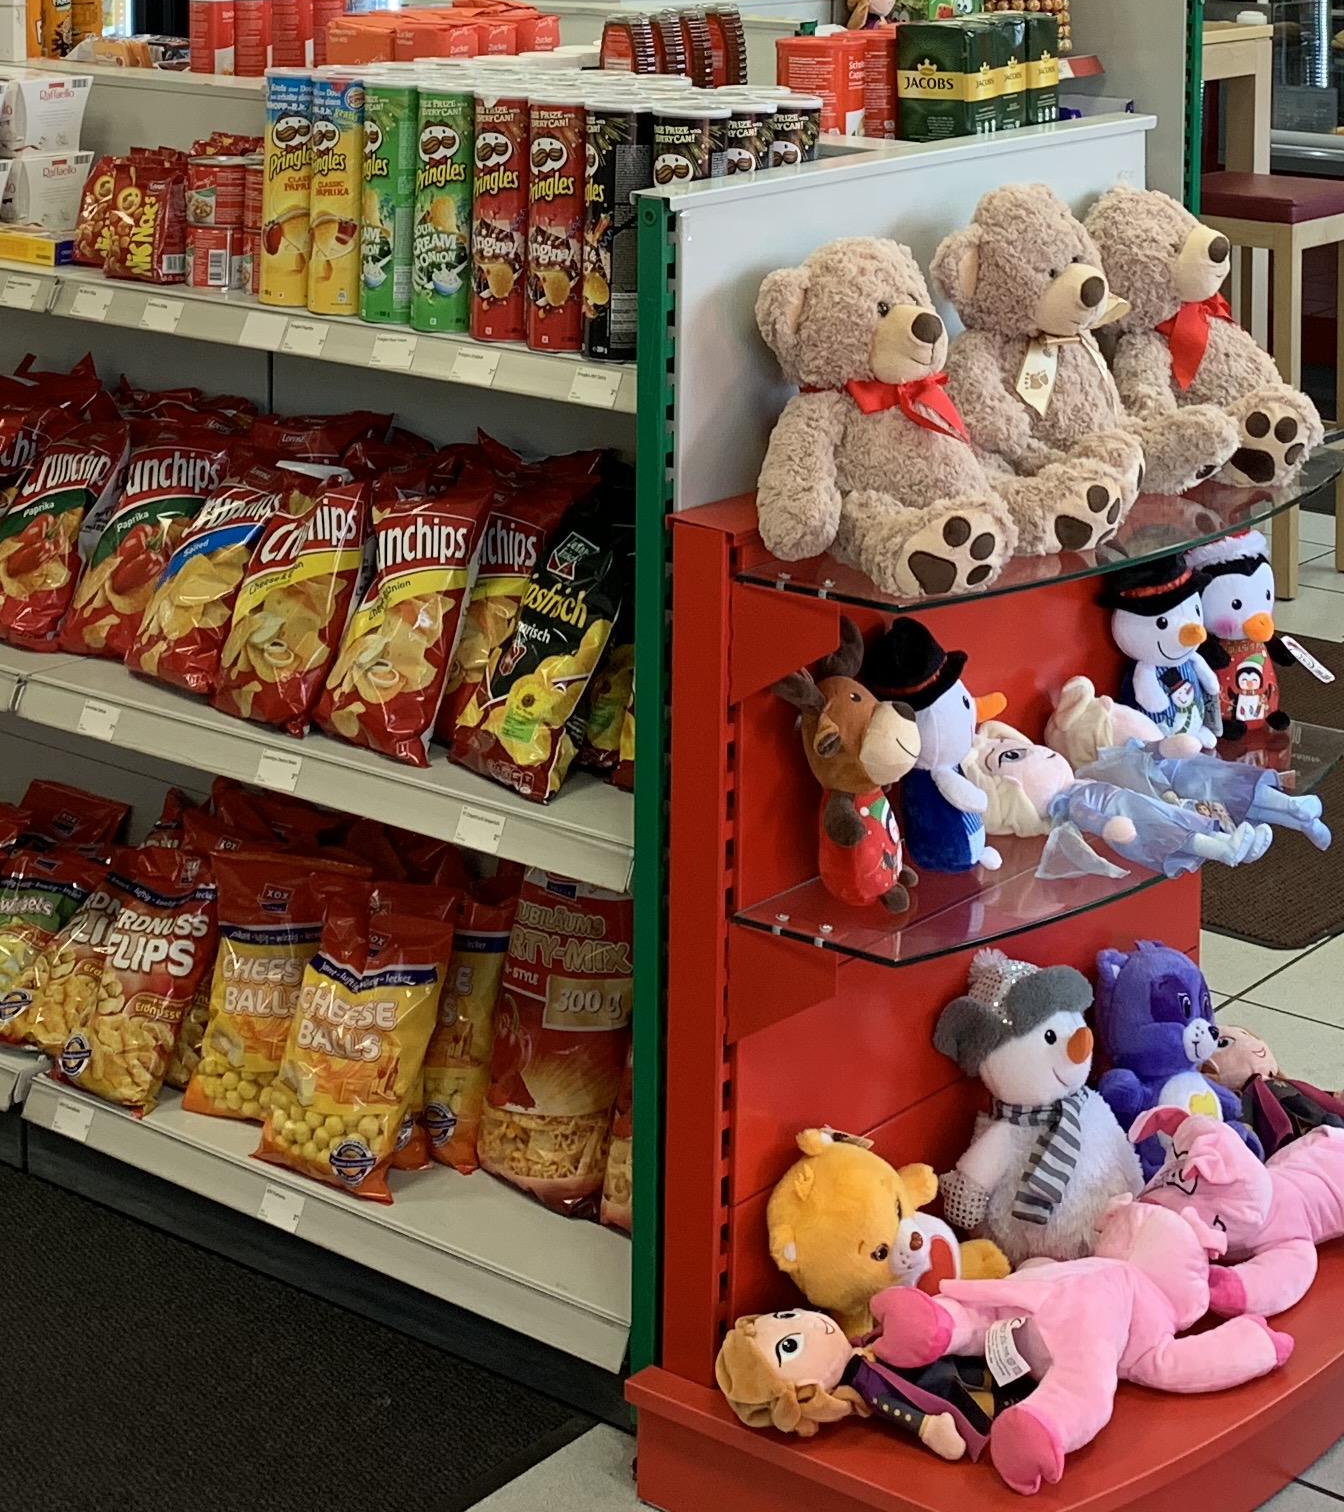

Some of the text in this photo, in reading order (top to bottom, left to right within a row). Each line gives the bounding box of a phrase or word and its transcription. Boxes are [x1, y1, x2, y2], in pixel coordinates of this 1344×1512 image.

[450, 36, 554, 54] Zucker Zucker Zucker
[904, 65, 1056, 90] JACOBS JACOBS JACOBS JACOBS
[39, 89, 74, 101] Raffaello
[664, 125, 690, 135] PRIZE
[673, 133, 696, 143] CAN!
[416, 157, 466, 191] Pringles
[315, 188, 349, 196] PAPRIKA
[281, 431, 310, 446] Lorenz
[24, 501, 55, 518] Paprika
[117, 510, 149, 532] Paprika
[183, 540, 209, 557] Salted
[266, 888, 290, 901] XOX
[135, 1000, 182, 1020] Erdnüsse
[299, 985, 397, 1030] CHEESE
[297, 1019, 384, 1062] BALLS
